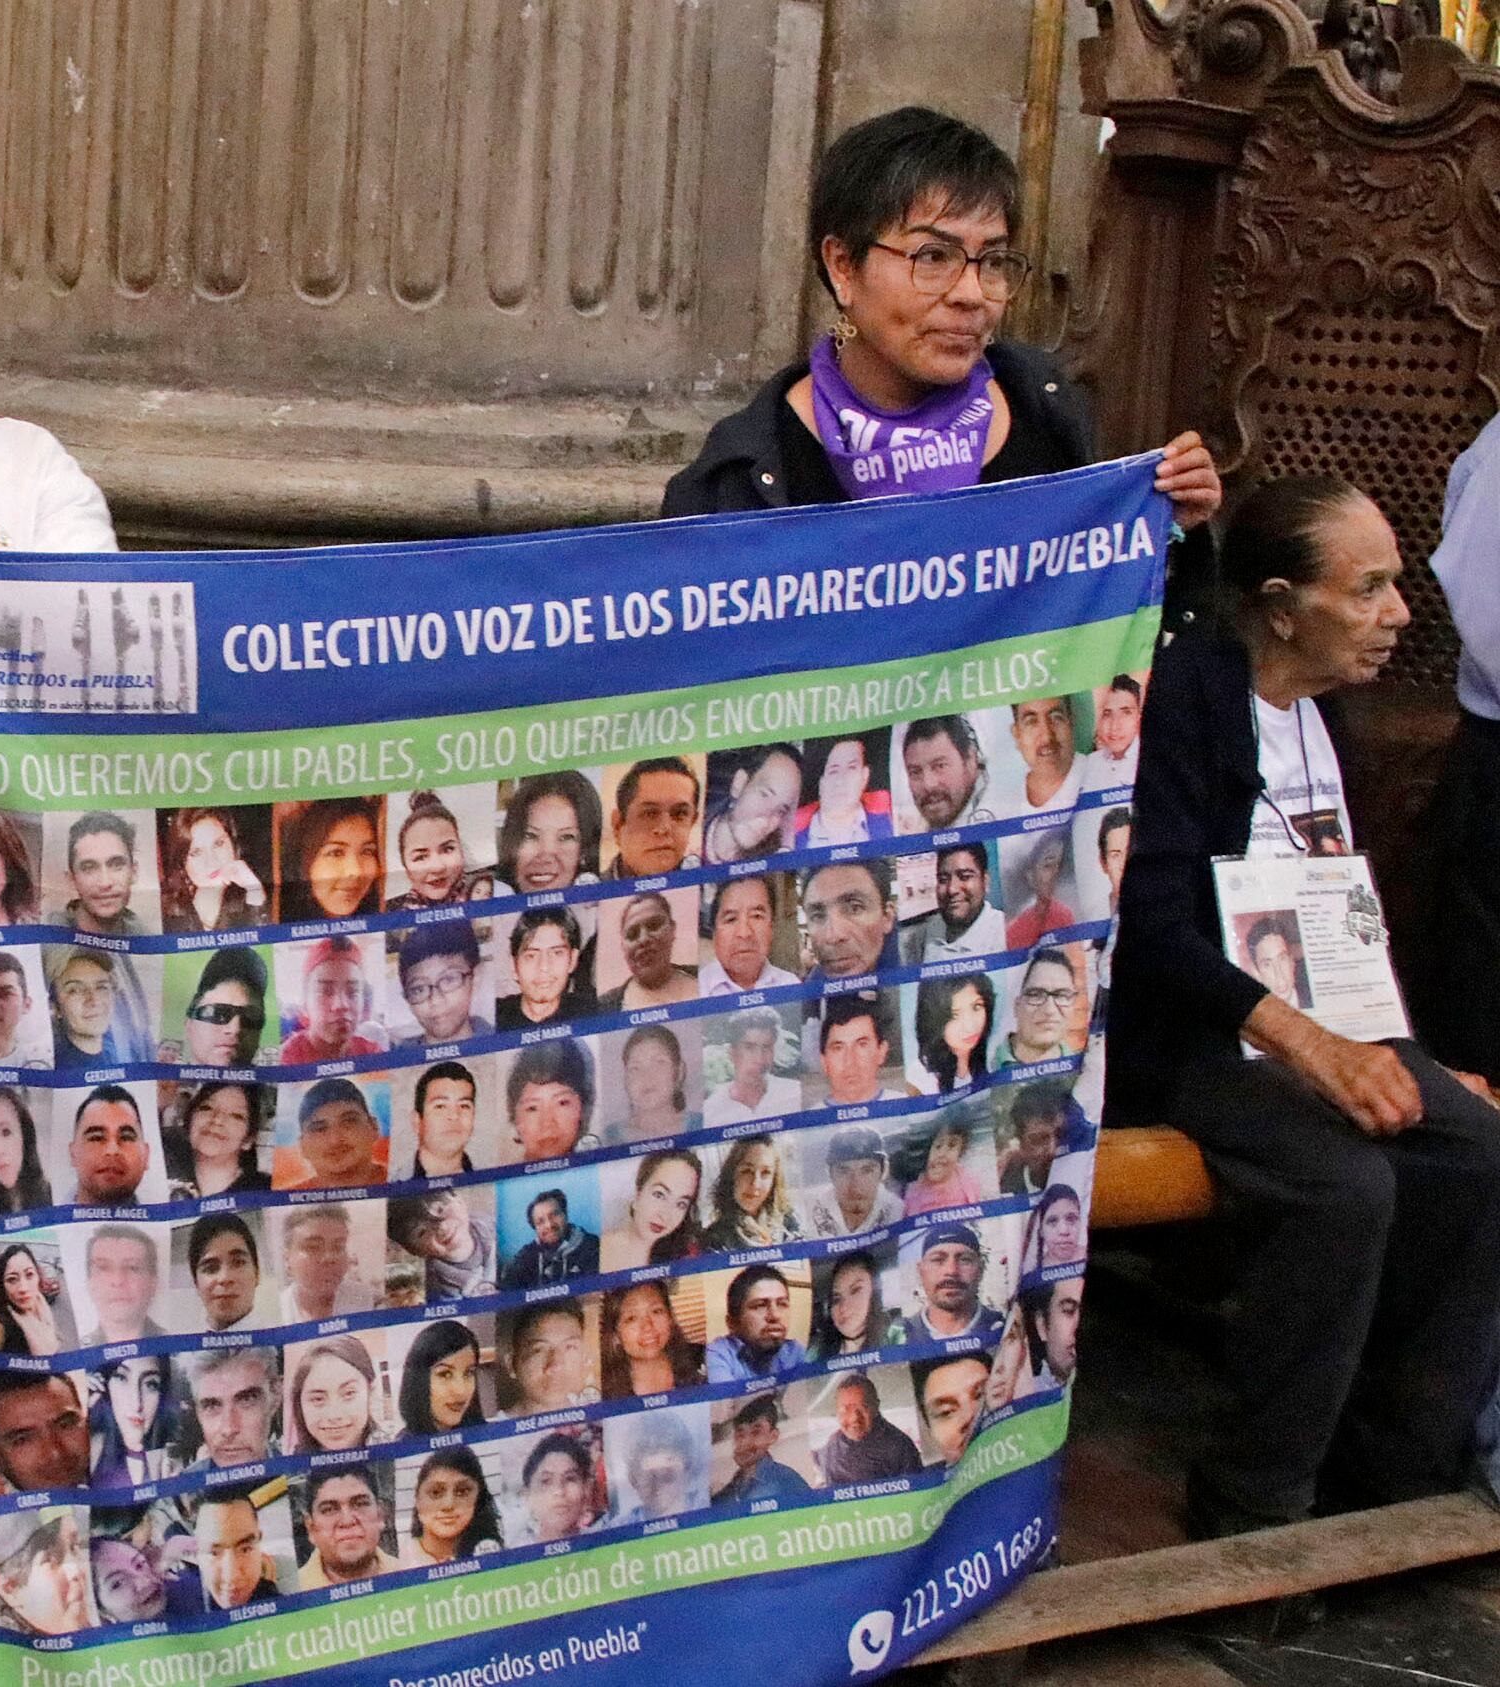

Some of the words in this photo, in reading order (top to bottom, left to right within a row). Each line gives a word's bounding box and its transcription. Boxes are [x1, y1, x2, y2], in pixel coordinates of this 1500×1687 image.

[853, 455, 886, 482] en
[891, 430, 978, 483] puebla"
[223, 612, 447, 673] COLECTIVO
[454, 603, 535, 657] VOZ
[544, 597, 594, 648] DE
[604, 588, 675, 641] LOS
[681, 553, 966, 632] DESAPARECIDOS
[975, 545, 1018, 593] EN
[1025, 516, 1156, 583] PUEBLA
[70, 676, 88, 688] en
[91, 675, 155, 688] PUEBLA
[20, 751, 213, 801] QUEREMOS
[224, 738, 425, 792] CULPABLES,
[436, 723, 517, 777] SOLO
[526, 709, 696, 767] QUEREMOS
[707, 671, 928, 739] ENCONTRARLOS
[934, 679, 953, 706] A
[961, 647, 1058, 699] ELLOS:
[932, 832, 961, 846] DIEGO
[634, 877, 667, 892] SERGIO
[434, 907, 466, 922] ELENA
[291, 924, 328, 938] KARINA
[177, 934, 216, 950] ROXANA
[952, 958, 987, 975] EDGAR
[629, 1008, 670, 1025] CLAUDIA
[425, 1045, 460, 1060] RAFAEL
[179, 1068, 221, 1080] MIGUEL
[1011, 1064, 1036, 1081] JUAN
[1036, 1059, 1073, 1076] CARLOS
[72, 1208, 112, 1219] MIGUEL
[931, 1206, 984, 1224] FERNANDA
[728, 1248, 784, 1265] ALEJANDRA
[524, 1285, 569, 1302] EDUARDO
[424, 1304, 459, 1318] ALEXIS
[201, 1334, 253, 1347] BRANDON
[945, 1338, 982, 1353] RUTILO
[8, 1357, 50, 1370] ARIANA
[826, 1351, 882, 1370] GUADALUPE
[537, 1410, 586, 1428] ARMANDO
[429, 1433, 464, 1449] EVELIN
[310, 1450, 370, 1467] MONSERRAT
[205, 1468, 228, 1485] JUAN
[229, 1464, 266, 1482] IGNACIO
[857, 1479, 911, 1497] FRANCISCO
[16, 1493, 51, 1507] CARLOS
[750, 1499, 778, 1515] JAIRO
[428, 1560, 482, 1580] ALEJANDRA
[901, 1580, 944, 1636] 222
[945, 1552, 991, 1608] 580
[994, 1517, 1042, 1577] 1683
[21, 1656, 131, 1687] Puedes
[140, 1634, 278, 1687] compartir
[286, 1604, 416, 1661] cualquier
[424, 1565, 600, 1636] información
[608, 1548, 644, 1590] de
[653, 1532, 770, 1579] manera
[777, 1509, 912, 1557] anónima
[132, 1622, 169, 1637] GLORIA
[33, 1637, 73, 1650] CARLOS
[538, 1649, 564, 1671] en
